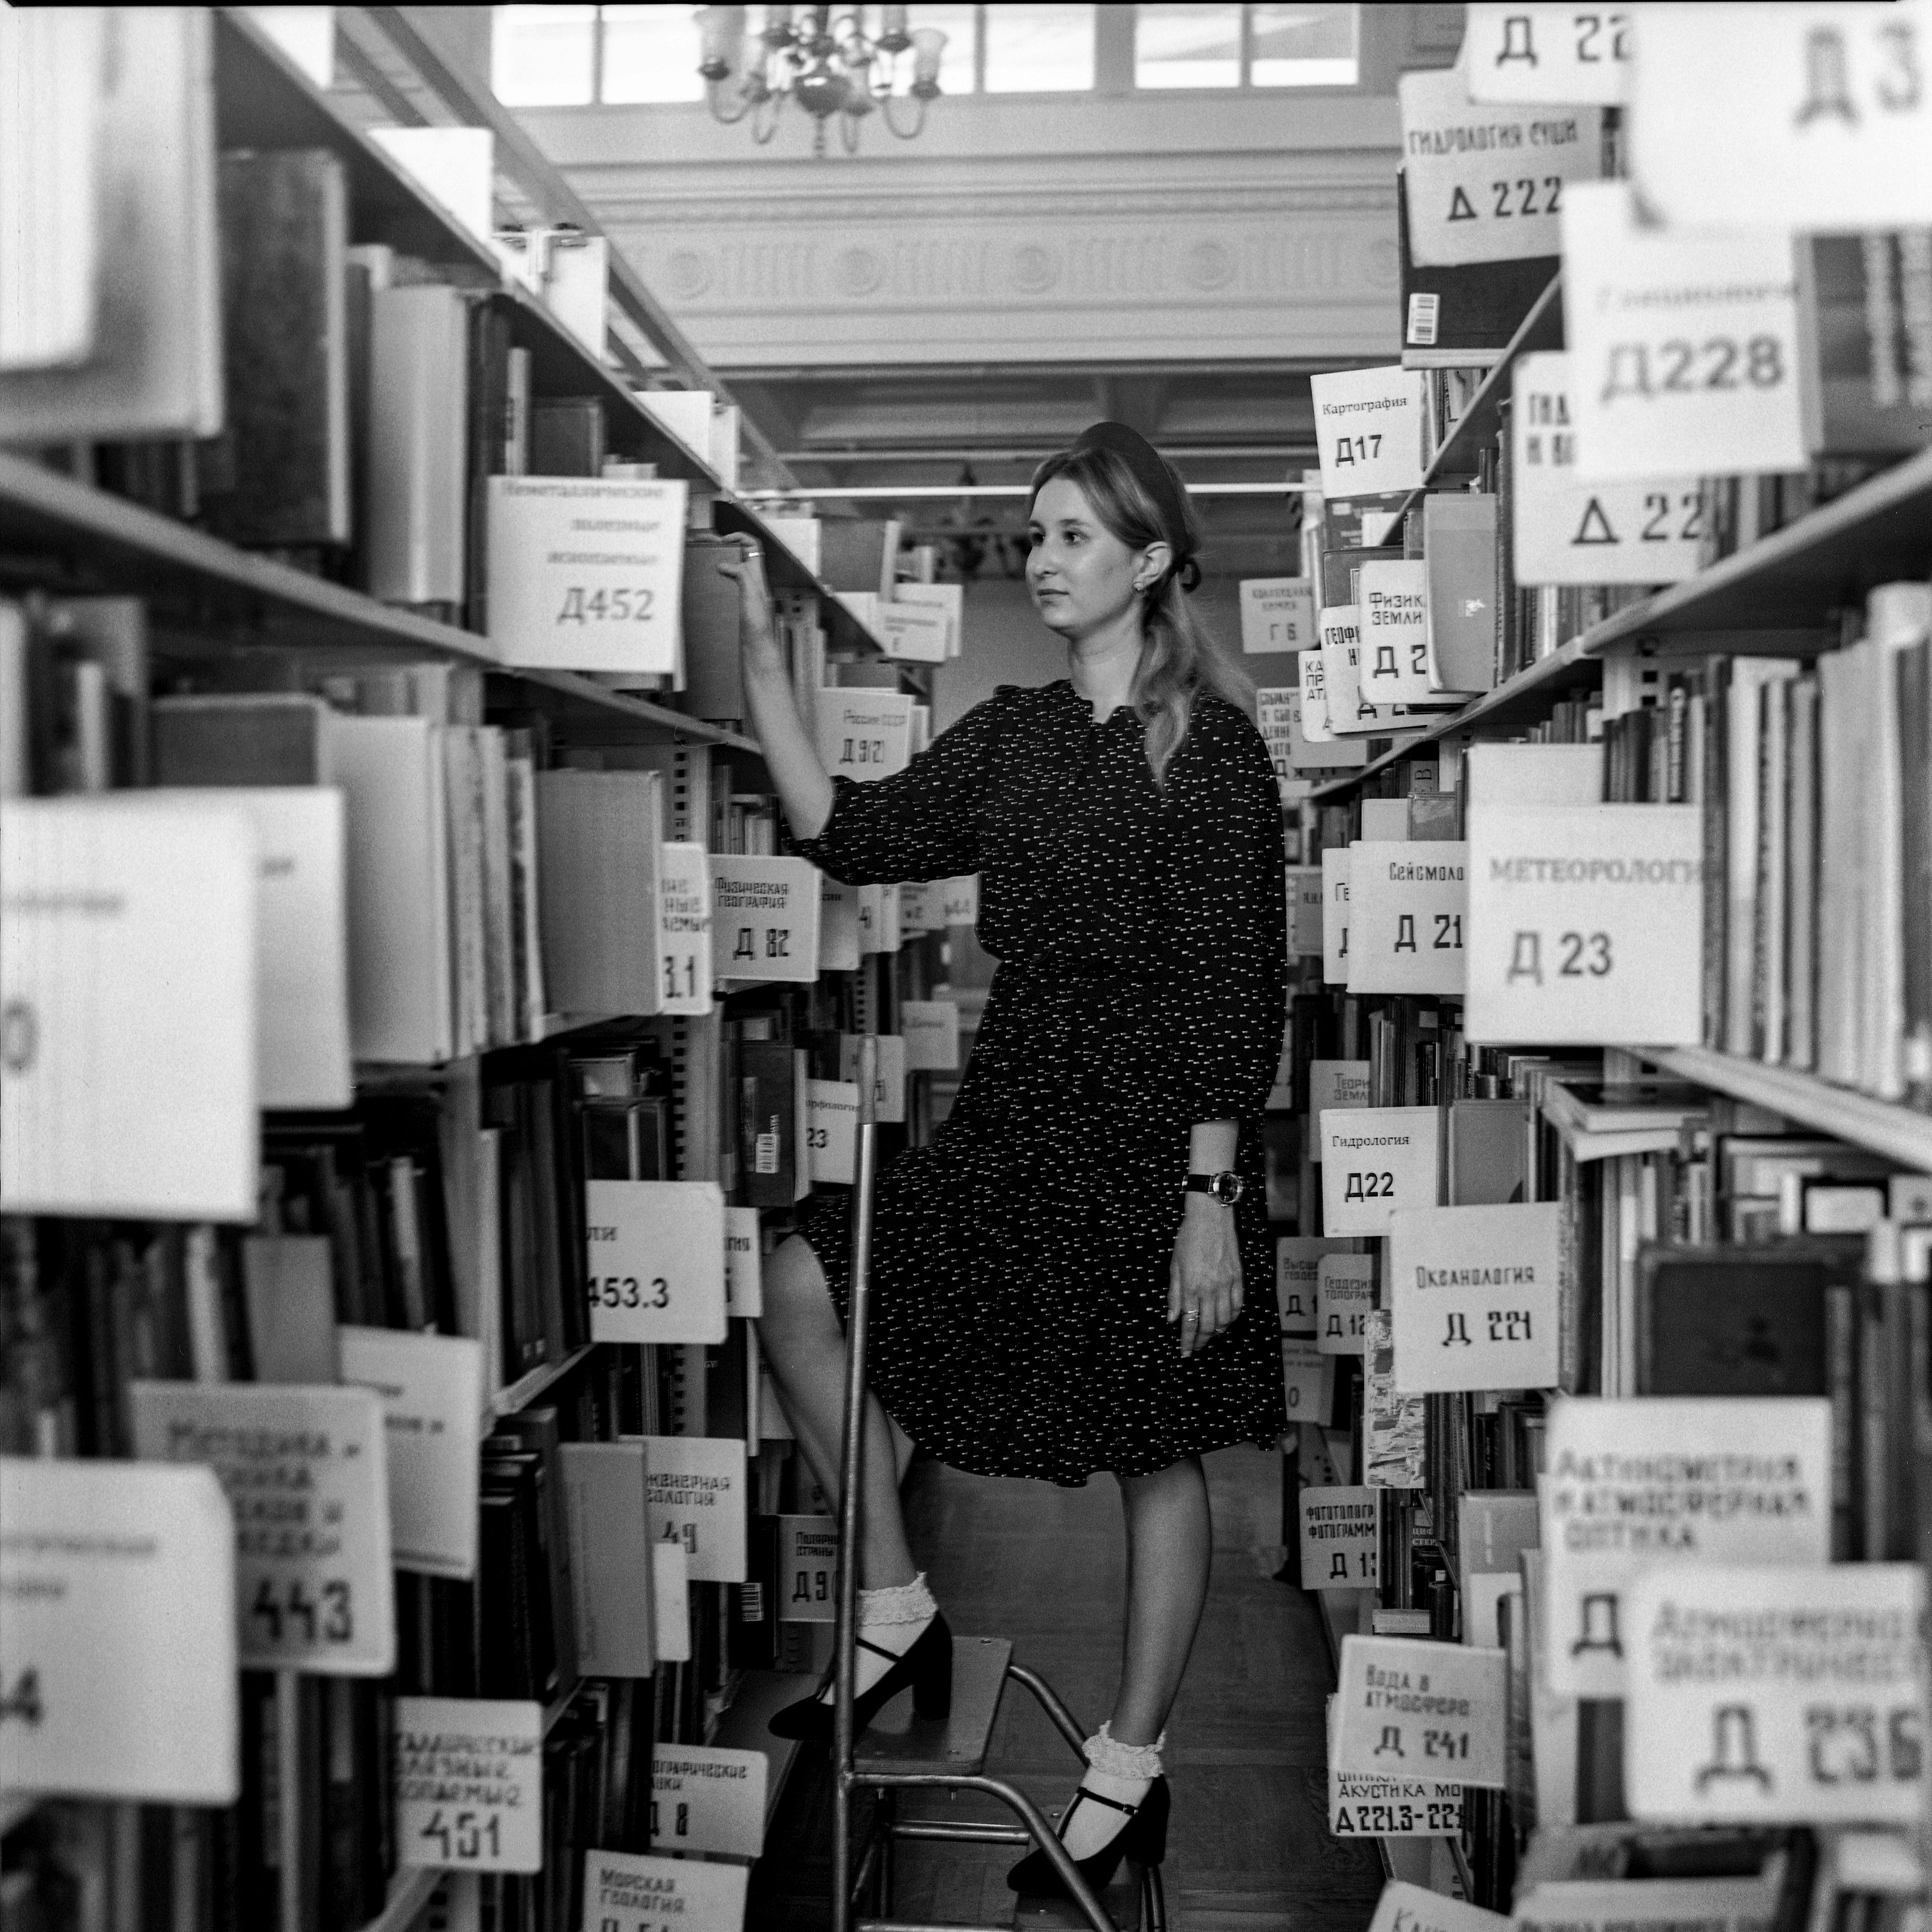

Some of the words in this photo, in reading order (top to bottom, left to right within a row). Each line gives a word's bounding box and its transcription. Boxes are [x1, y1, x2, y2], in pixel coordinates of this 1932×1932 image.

[1495, 17, 1538, 68] Д
[1790, 23, 1864, 134] Д
[1447, 186, 1478, 221] Д
[1492, 176, 1562, 217] 222
[1599, 335, 1786, 408] Д228
[1322, 397, 1407, 415] Картография
[1335, 434, 1382, 468] Д17
[1571, 496, 1619, 545] Д
[1641, 494, 1702, 541] 22
[557, 586, 655, 626] Д452
[1372, 611, 1422, 625] ЗЕМЛИ
[1373, 646, 1398, 678] Д
[732, 928, 755, 961] Д
[765, 928, 790, 958] 82
[1394, 914, 1417, 952] Д
[1433, 914, 1463, 949] 21
[1506, 931, 1543, 986] Д
[1558, 931, 1613, 977] 23
[1332, 1135, 1410, 1149] Гидрология
[1344, 1171, 1395, 1203] Д22
[1326, 1315, 1343, 1338] Д
[1441, 1312, 1473, 1346] Д
[1330, 1552, 1347, 1579] Д
[792, 1571, 811, 1603] Д
[253, 1577, 352, 1644] 443
[1571, 1594, 1624, 1659] Д
[1374, 1725, 1405, 1758] Д
[1693, 1702, 1774, 1798] Д
[1338, 1783, 1426, 1798] АКУСТИКА
[420, 1809, 500, 1860] 451
